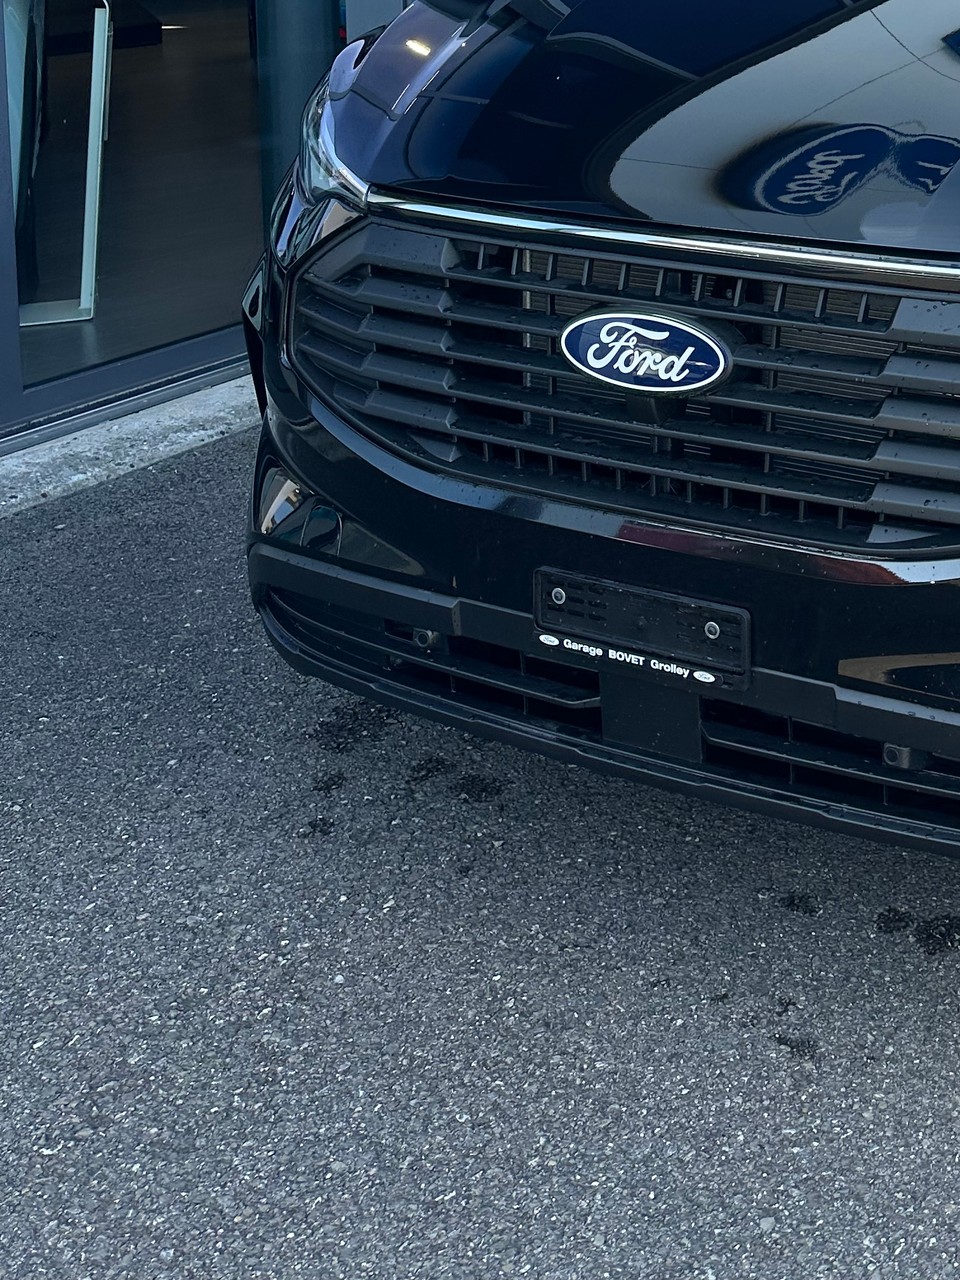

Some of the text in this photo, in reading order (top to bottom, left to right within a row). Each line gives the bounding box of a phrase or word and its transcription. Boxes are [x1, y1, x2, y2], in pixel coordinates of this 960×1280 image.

[586, 321, 696, 382] Ford
[563, 638, 603, 657] Garage
[608, 649, 645, 666] BOVET
[650, 659, 690, 678] Grolley
